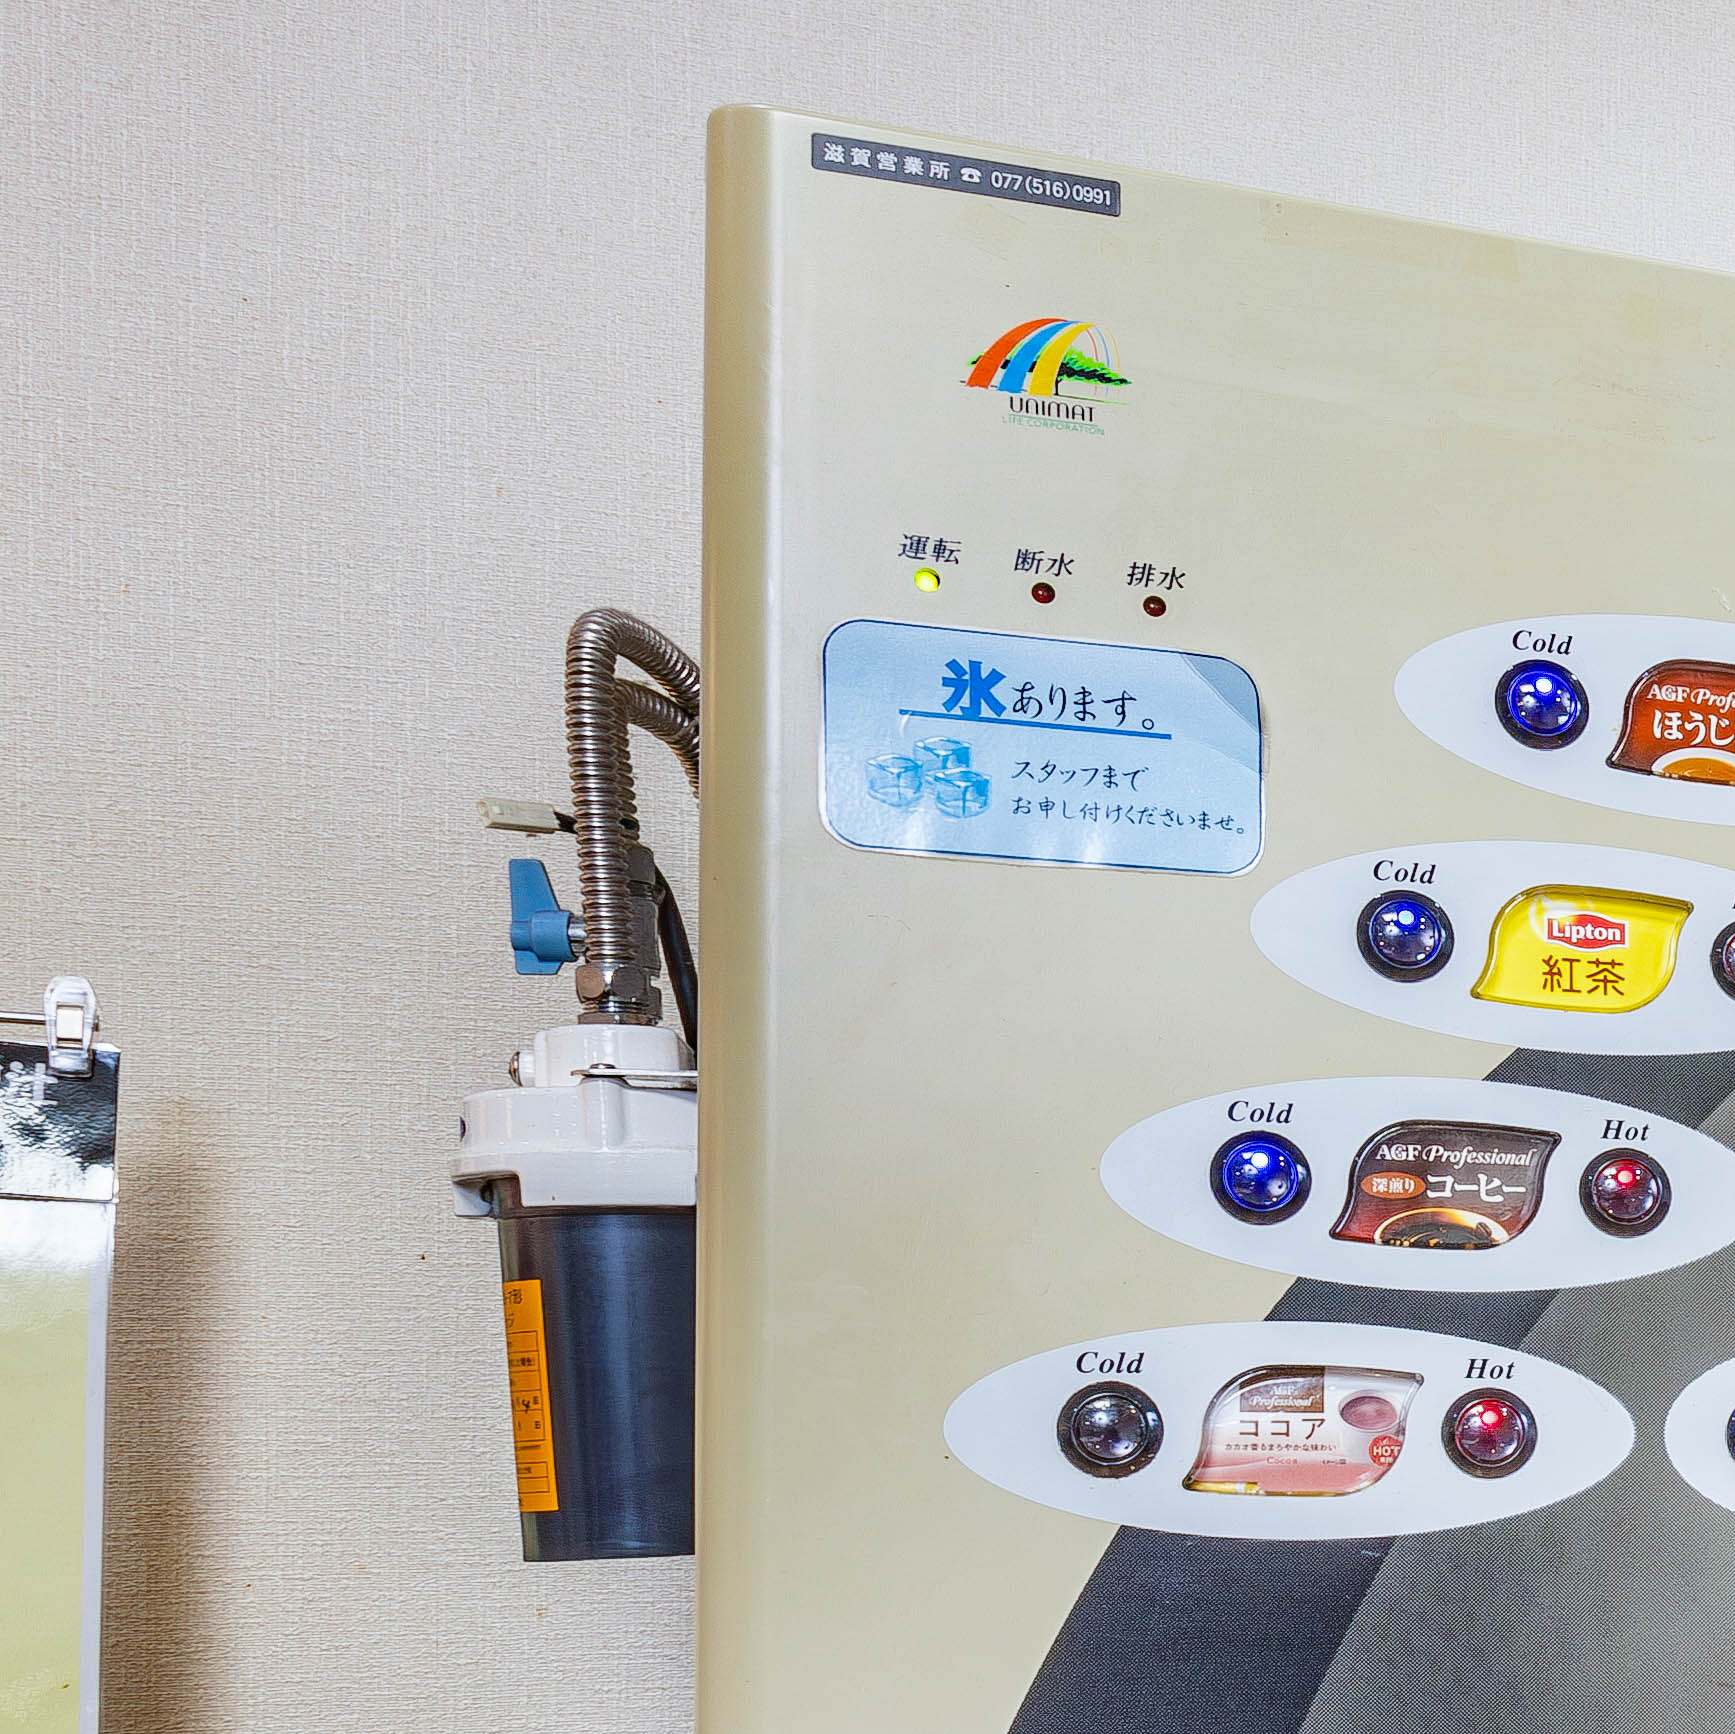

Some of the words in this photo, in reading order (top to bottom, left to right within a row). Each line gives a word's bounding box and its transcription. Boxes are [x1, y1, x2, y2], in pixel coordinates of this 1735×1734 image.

[823, 142, 951, 181] 滋賀営業所
[990, 169, 1112, 206] 077(516)0991
[1008, 395, 1097, 423] UNIMAT
[898, 534, 962, 565] 運転
[1013, 548, 1075, 578] 断水
[1127, 561, 1186, 591] 排水
[1511, 628, 1573, 656] Cold
[941, 658, 1156, 732] 氷あります。
[1646, 681, 1689, 703] AGF
[1011, 760, 1151, 793] スタッフまで
[1012, 796, 1246, 836] お申し付けくださいませ。
[1372, 858, 1438, 886] Cold
[1551, 919, 1623, 945] Lipton
[1541, 954, 1626, 997] 紅茶
[1226, 1099, 1294, 1126] Cold
[1601, 1118, 1651, 1143] Hot
[1376, 1143, 1420, 1164] AGF
[1422, 1144, 1538, 1169] Professional
[1426, 1172, 1527, 1204] コーヒー
[1075, 1350, 1146, 1377] Cold
[1464, 1357, 1517, 1382] Hot
[1239, 1417, 1326, 1441] ココア
